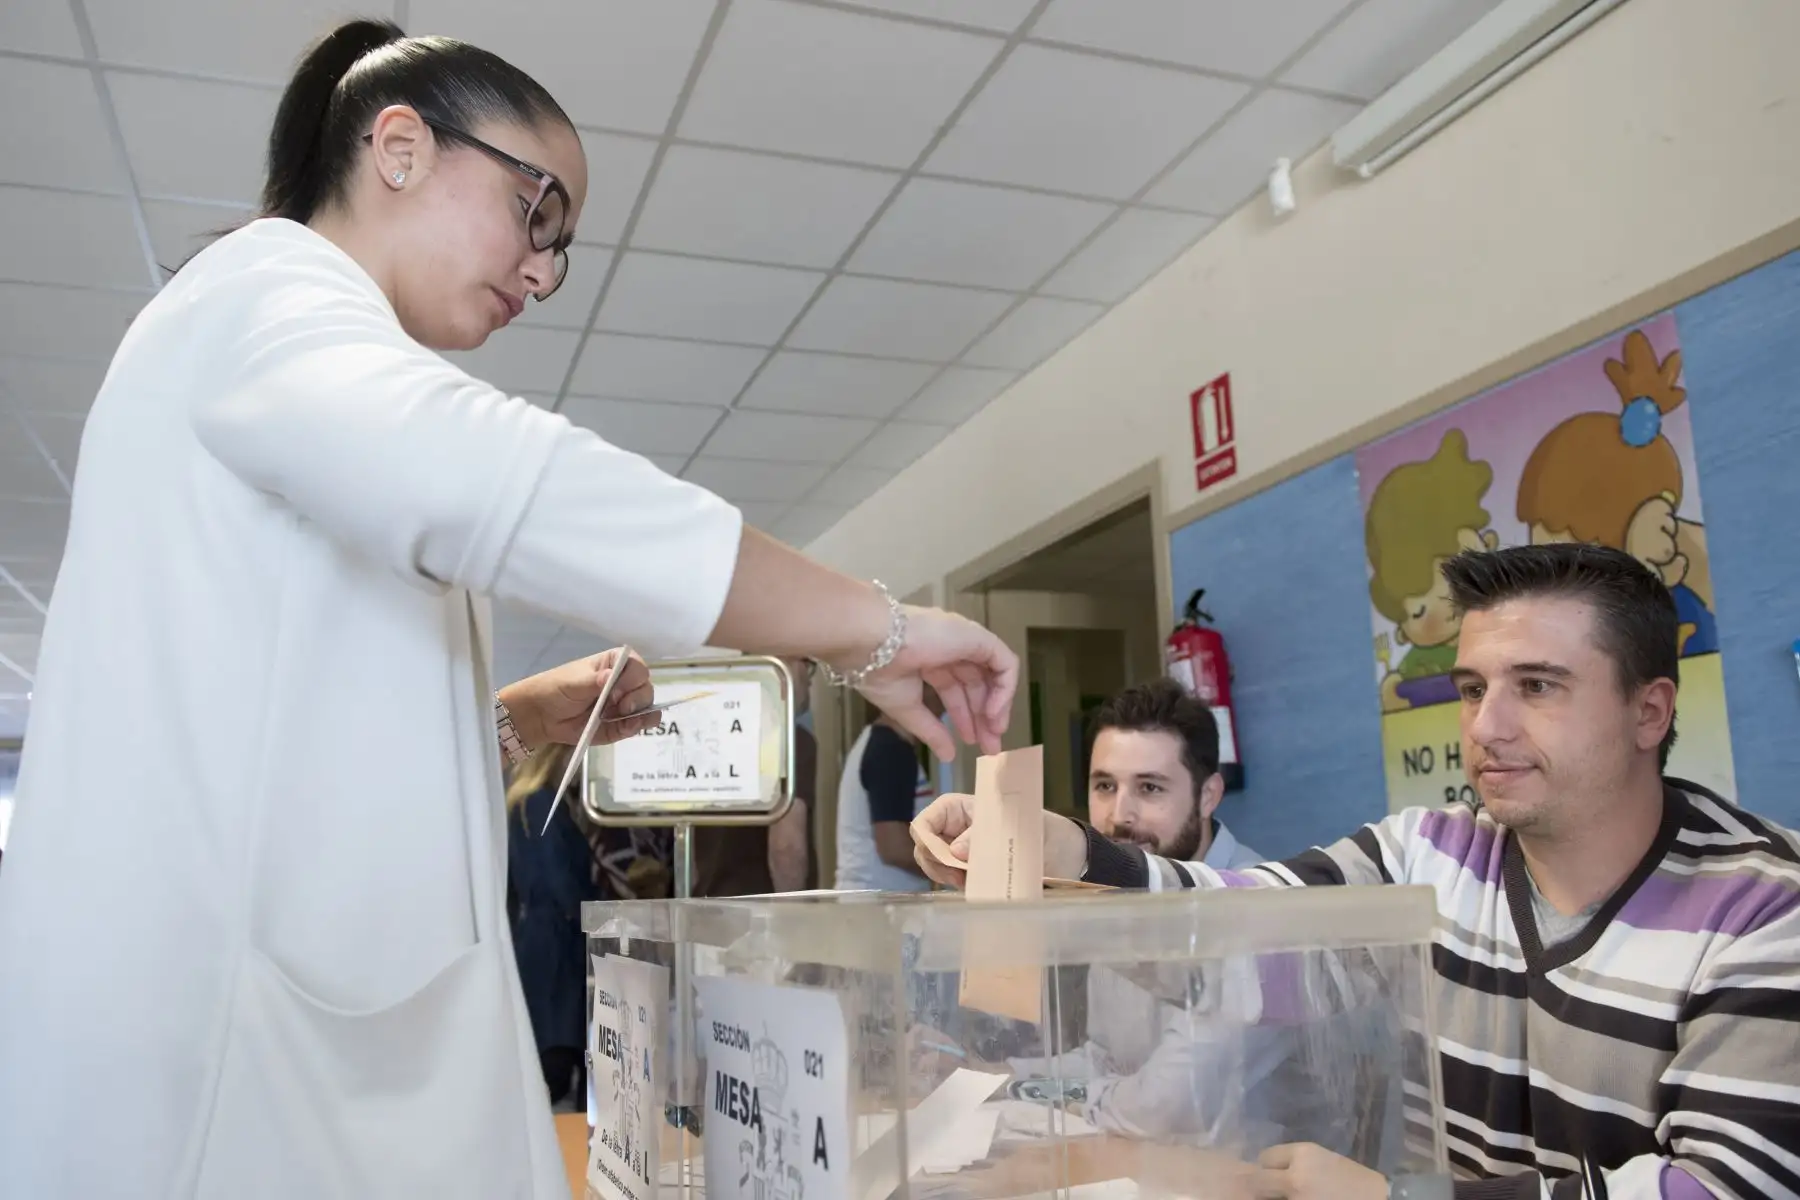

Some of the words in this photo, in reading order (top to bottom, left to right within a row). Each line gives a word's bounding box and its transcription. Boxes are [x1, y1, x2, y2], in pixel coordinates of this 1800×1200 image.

[723, 701, 741, 709] 021
[730, 719, 743, 733] A
[685, 765, 697, 778] A
[729, 764, 740, 777] L
[1403, 746, 1434, 776] NO
[598, 1023, 625, 1067] MESA
[643, 1047, 651, 1083] A
[804, 1048, 824, 1080] 021
[715, 1069, 763, 1134] MESA
[812, 1115, 829, 1171] A
[623, 1135, 631, 1168] A
[644, 1150, 650, 1186] L
